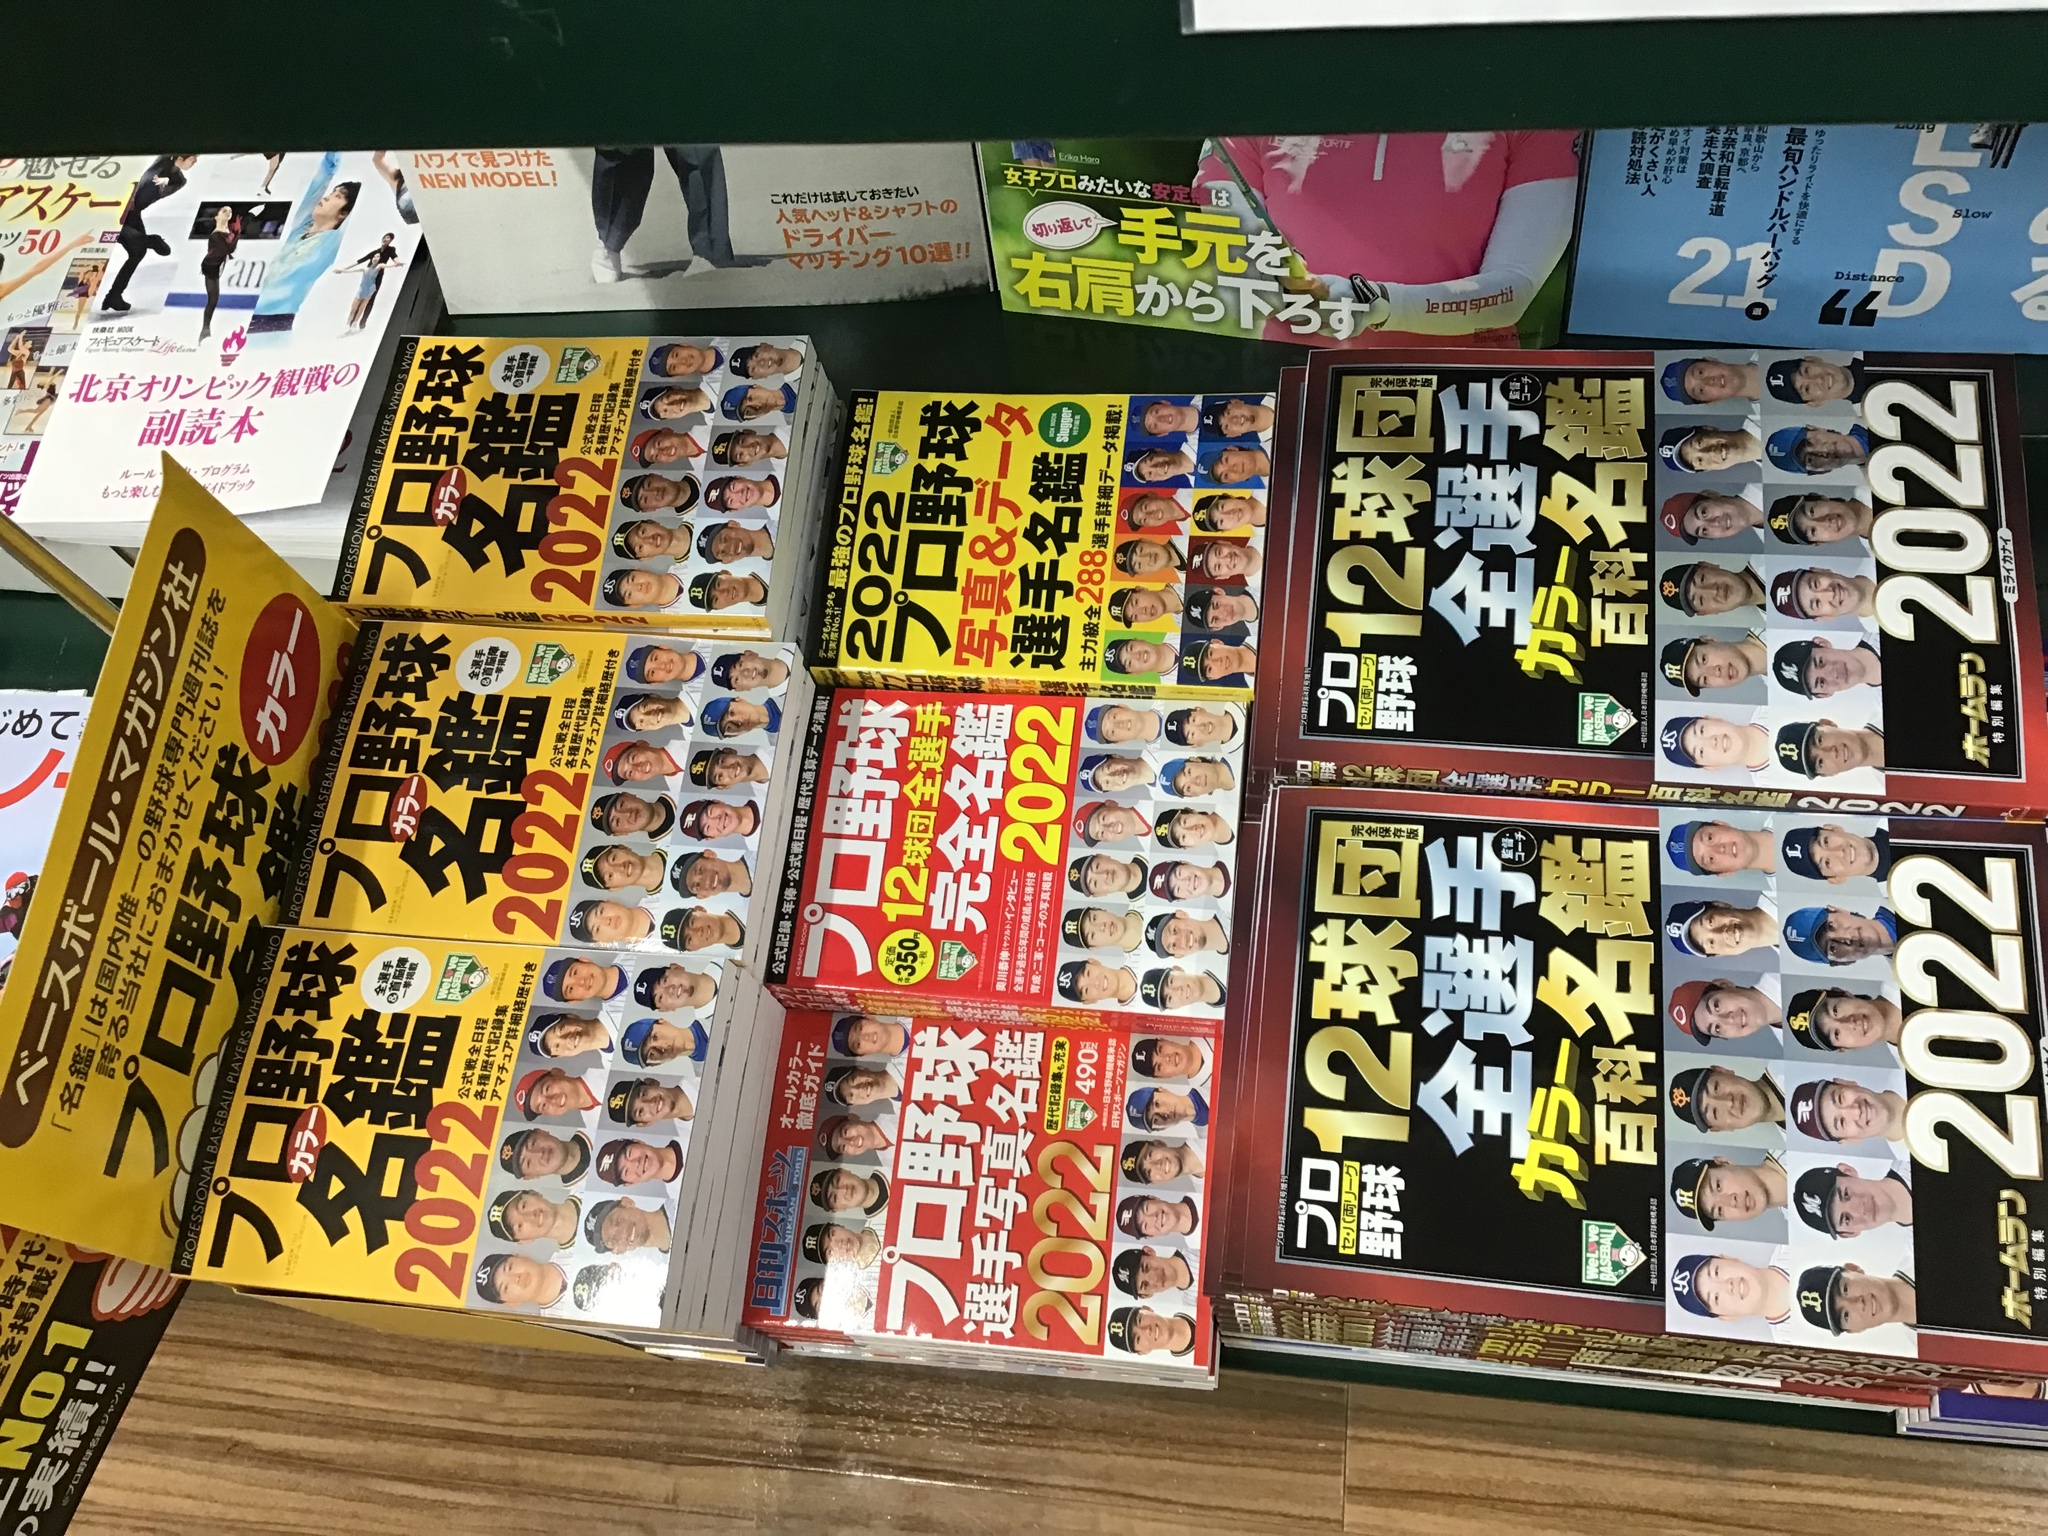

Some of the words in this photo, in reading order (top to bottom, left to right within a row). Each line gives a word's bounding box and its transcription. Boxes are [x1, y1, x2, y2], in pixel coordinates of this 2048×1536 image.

[413, 150, 553, 169] ハワイで見つけた
[420, 172, 467, 189] NEW
[471, 171, 559, 188] MODEL!
[770, 185, 920, 206] これだけは試しておきたい
[1059, 152, 1077, 161] Erika
[1079, 154, 1101, 164] Hara
[1792, 129, 1826, 245] ゆったりライドを快適にする
[776, 199, 959, 225] 人気ヘッド&シャフトの
[783, 227, 892, 249] ドライバー
[1032, 217, 1093, 238] 切り返しで
[1118, 207, 1295, 276] 手元を
[1757, 127, 1808, 289] 最旬ハンドルバーバッグ
[1952, 208, 1993, 219] Slow
[1012, 252, 1369, 341] 右肩から下ろす
[1426, 299, 1440, 313] le
[1442, 301, 1467, 315] coq
[1470, 286, 1514, 313] sportif
[1835, 271, 1905, 284] Distance
[69, 363, 361, 403] 北京オリンピック観戦の
[137, 406, 264, 447] 副読本
[581, 393, 605, 456] 公式戦全日程
[595, 382, 621, 456] 各種歴代記録集
[609, 349, 643, 456] アマチュア詳細経歴付き
[1056, 407, 1073, 443] Slugger
[1370, 377, 1433, 388] 完全保存版
[1521, 375, 1532, 401] コーチ
[339, 505, 370, 598] PROFESSIONAL
[362, 457, 385, 506] BASEBALL
[376, 413, 397, 456] PLAYERS
[391, 372, 408, 412] WHO'S
[402, 341, 418, 369] WHO
[363, 344, 485, 595] プロ野球
[434, 468, 460, 521] カラー
[441, 391, 580, 578] 名鑑
[828, 397, 874, 590] 最強のプロ野球名鑑!
[1540, 377, 1648, 549] 名鑑
[530, 457, 618, 606] 2022
[890, 400, 982, 665] プロ野球
[954, 401, 1034, 669] 写真&データ
[1325, 375, 1437, 647] 12球団
[1429, 377, 1541, 647] 全選手
[1862, 379, 2001, 646] 2022
[846, 490, 905, 663] 2022
[1009, 451, 1088, 672] 選手名鑑
[2001, 533, 2016, 596] ミライカナイ
[818, 592, 836, 658] データも小ネタも
[1514, 545, 1584, 684] カラー
[256, 607, 303, 756] カラー
[580, 649, 620, 769] アマチュア詳細経歴付き
[1317, 652, 1359, 727] プロ
[1359, 655, 1375, 727] セ・パ両リーグ
[1375, 655, 1417, 732] 野球
[1593, 698, 1611, 742] BASEBALL
[1959, 652, 1990, 769] ホームラン
[1991, 683, 2005, 745] 特別編集
[550, 698, 577, 768] 公式戦全日程
[564, 687, 596, 769] 各種歴代記録集
[288, 818, 323, 919] PROFESSIONAL
[311, 762, 339, 818] BASEBALL
[329, 711, 354, 758] PLAYERS
[345, 664, 364, 707] WHO'S
[358, 629, 380, 659] WHO
[314, 633, 451, 918] プロ野球
[392, 776, 419, 836] カラー
[399, 693, 551, 904] 名鑑
[881, 701, 955, 921] 12球団全選手
[930, 702, 1014, 935] 完全名鑑
[1001, 706, 1077, 865] 2022
[1796, 796, 1966, 817] 2022
[16, 560, 198, 1105] ベースボール・マガジン社
[51, 587, 226, 1132] 「名鑑」は国内唯一の野球専門週刊誌を
[493, 770, 589, 940] 2022
[803, 699, 910, 978] プロ野球
[1351, 825, 1419, 840] 完全保存版
[1514, 831, 1526, 862] コーチ
[103, 741, 271, 1179] プロ野球
[374, 960, 394, 997] 全選手
[447, 958, 473, 1000] BASEBALL
[885, 946, 897, 967] 定価
[1537, 834, 1655, 1044] 名鑑
[490, 961, 538, 1102] アマチュア詳細経歴付き
[1303, 820, 1424, 1154] 12球団
[1417, 830, 1536, 1159] 全選手
[1887, 854, 2044, 1180] 2022
[458, 1017, 490, 1100] 公式戦全日程
[474, 1005, 510, 1101] 各種歴代記録集
[780, 1041, 802, 1129] オールカラー
[796, 1042, 825, 1130] 徹底ガイド
[1046, 1040, 1067, 1131] 歴代記録集も充実
[1075, 1049, 1099, 1095] 490
[1080, 1041, 1098, 1050] YEN
[1111, 1043, 1127, 1128] 日刊スポーツマガジン
[180, 1155, 217, 1268] PROFESSIONAL
[205, 1096, 235, 1158] BASEBALL
[222, 1040, 252, 1092] PLAYERS
[240, 986, 264, 1035] WHO'S
[257, 935, 282, 970] WHO
[207, 941, 358, 1268] プロ野球
[289, 1106, 318, 1176] カラー
[296, 1008, 462, 1256] 名鑑
[1511, 1038, 1588, 1211] カラー
[394, 1101, 499, 1300] 2022
[784, 1196, 797, 1244] NIKKAN
[886, 1026, 990, 1331] プロ野球
[962, 1030, 1044, 1339] 選手写真名鑑
[1295, 1158, 1340, 1249] プロ
[1341, 1164, 1358, 1252] セ・パ両リーグ
[1359, 1165, 1405, 1260] 野球
[751, 1149, 793, 1309] 日刊スポーツ
[1022, 1141, 1116, 1347] 2022
[1599, 1229, 1618, 1282] BASEBALL
[1998, 1188, 2032, 1330] ホームラン
[2031, 1229, 2047, 1300] 特別編集
